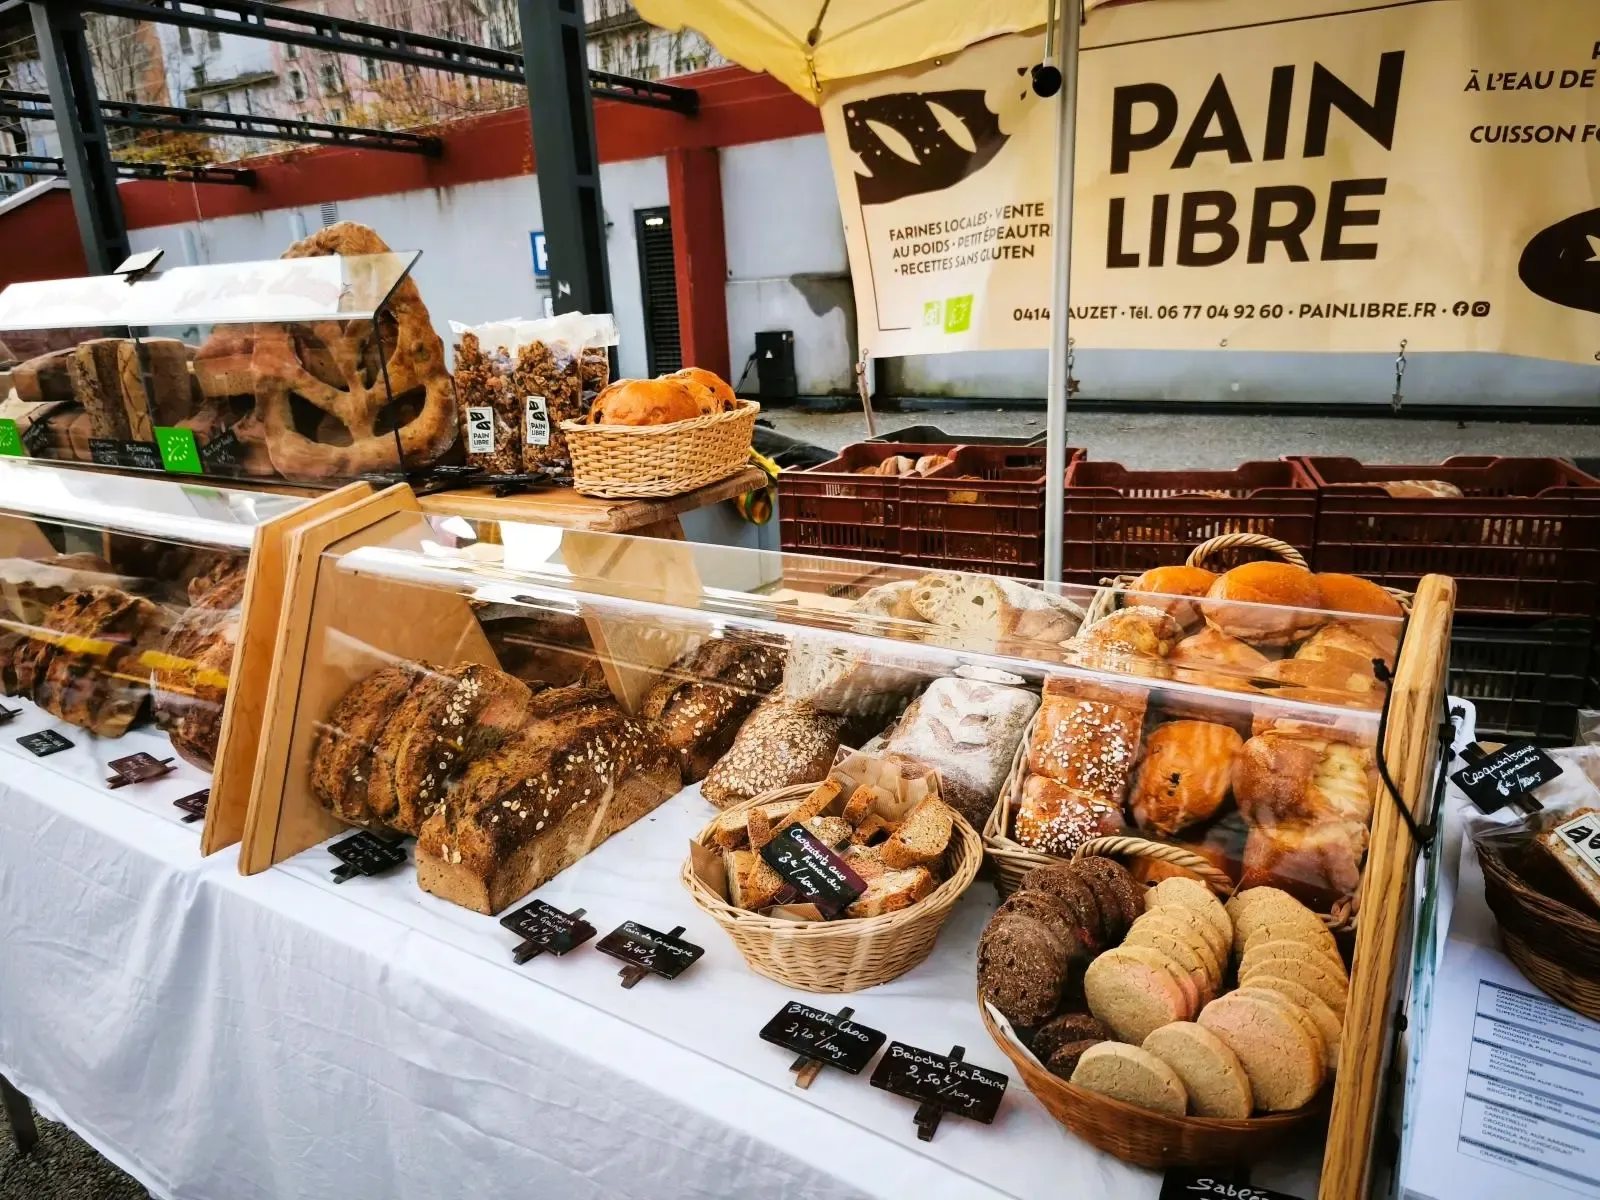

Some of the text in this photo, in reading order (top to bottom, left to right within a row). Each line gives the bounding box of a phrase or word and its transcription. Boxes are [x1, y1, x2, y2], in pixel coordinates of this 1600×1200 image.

[1559, 69, 1596, 89] DE
[1110, 50, 1405, 175] PAIN
[1470, 125, 1577, 143] CUISSON
[889, 202, 1044, 242] FARINES LOCALES VENTE
[1106, 177, 1387, 269] LIBRE
[893, 223, 1054, 260] AU POIDS PETIT ÉPEAUTR
[901, 245, 1035, 276] RECETTES SANS GLUTEN
[1129, 306, 1153, 319] Tél.
[1157, 306, 1178, 319] 06
[1183, 306, 1202, 319] 77
[1206, 305, 1229, 319] 04
[1233, 304, 1256, 319] 92
[1259, 304, 1283, 318] 60
[1298, 302, 1437, 319] PAINLIBRE.FR
[623, 922, 640, 936] Pain
[654, 937, 694, 958] Campagne
[787, 1003, 870, 1042] Brioche Choco
[891, 1046, 1006, 1090] Brioche Pur Beurre
